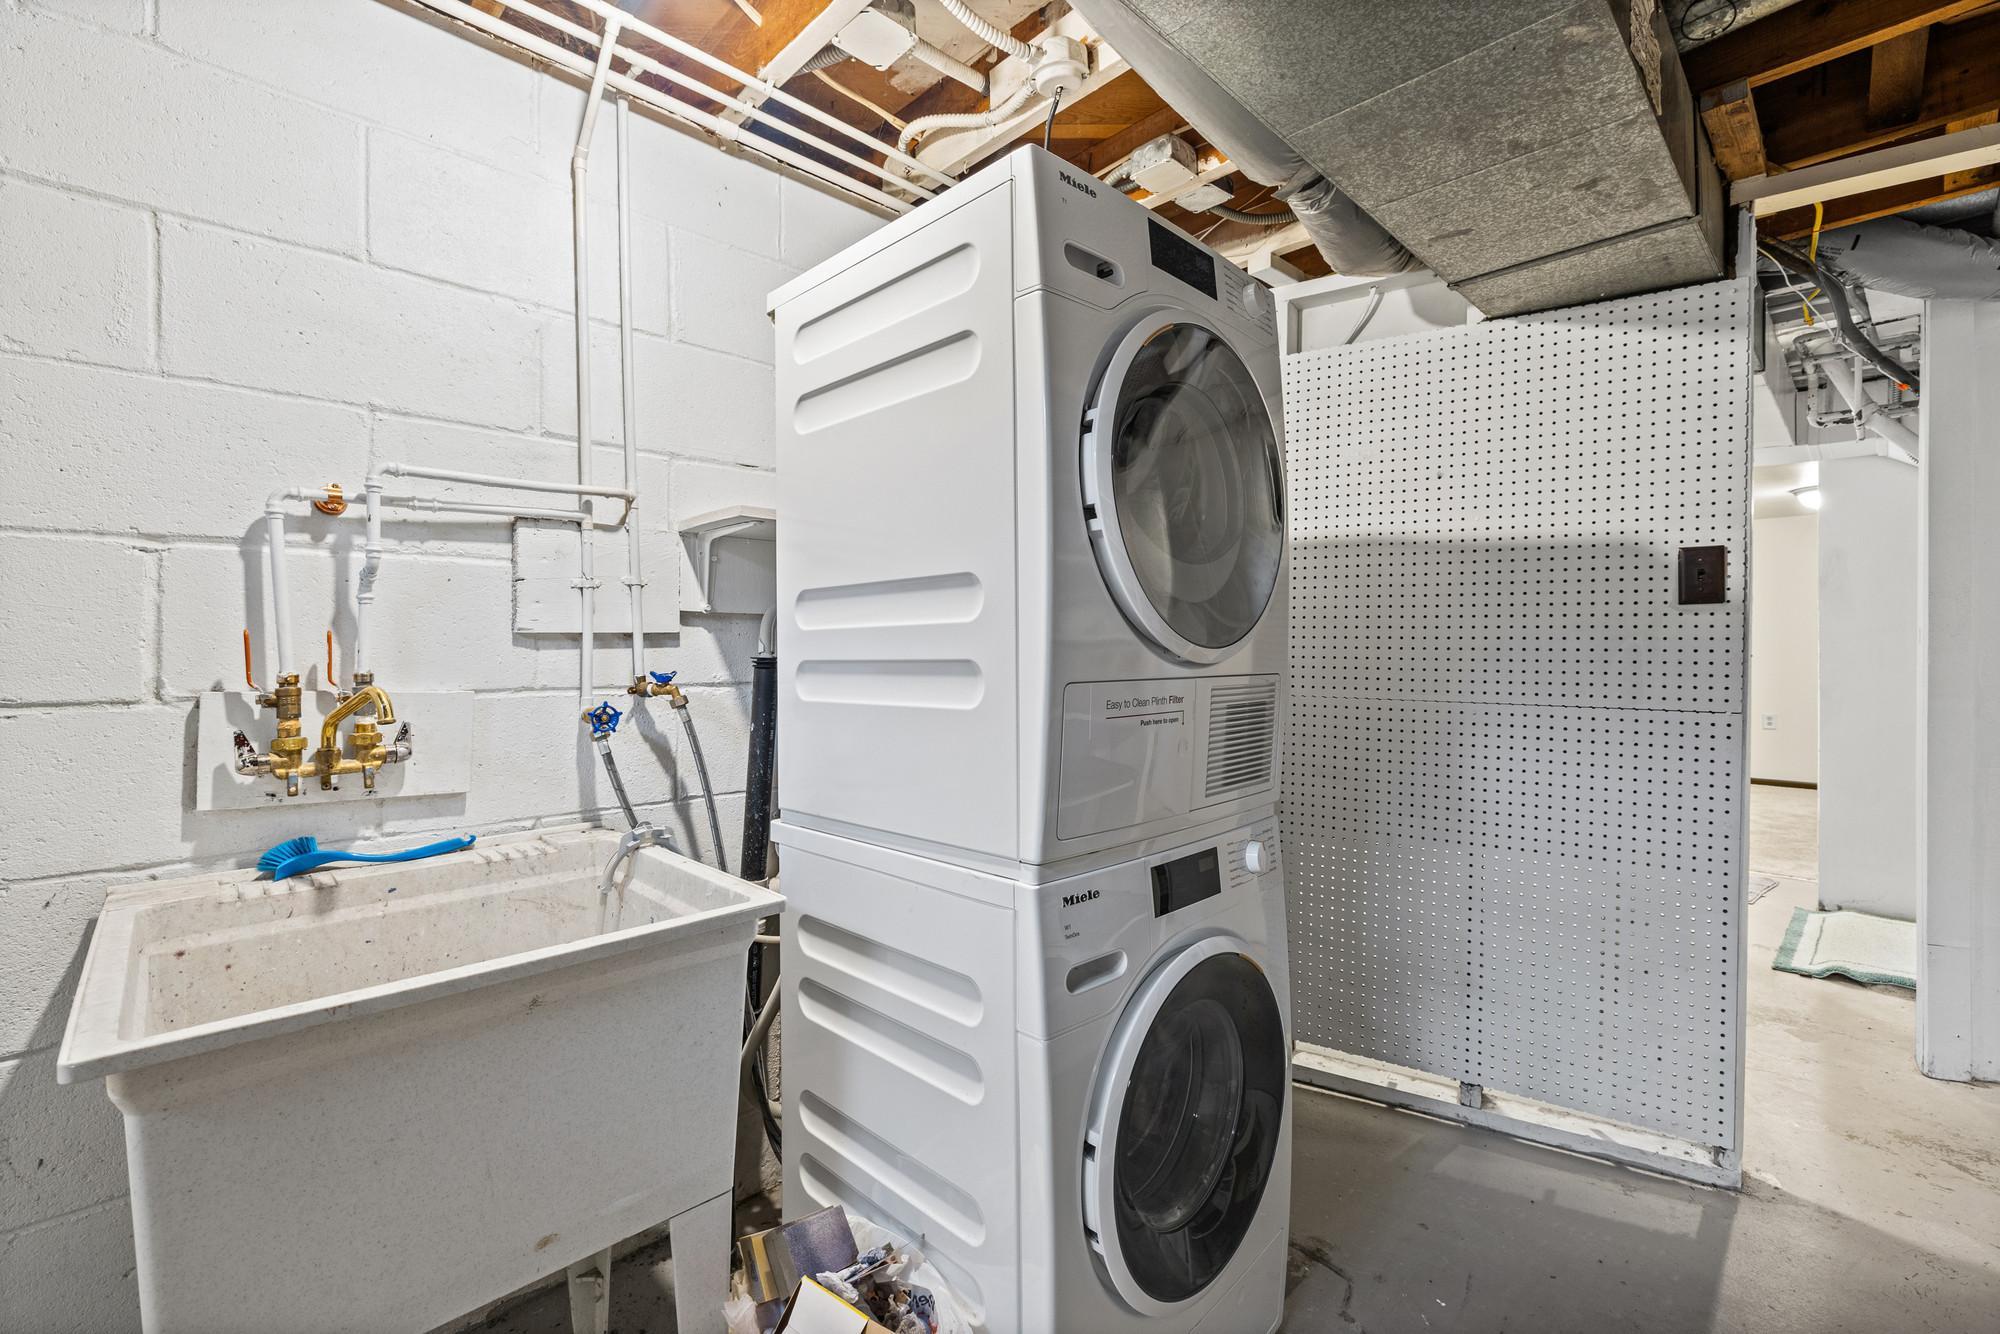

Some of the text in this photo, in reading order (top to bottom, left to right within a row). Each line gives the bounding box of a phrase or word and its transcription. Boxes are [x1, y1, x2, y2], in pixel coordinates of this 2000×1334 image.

[1059, 170, 1097, 199] Miele
[1106, 696, 1184, 711] Easy to Clean Plinth Filter
[1062, 889, 1100, 908] Miele
